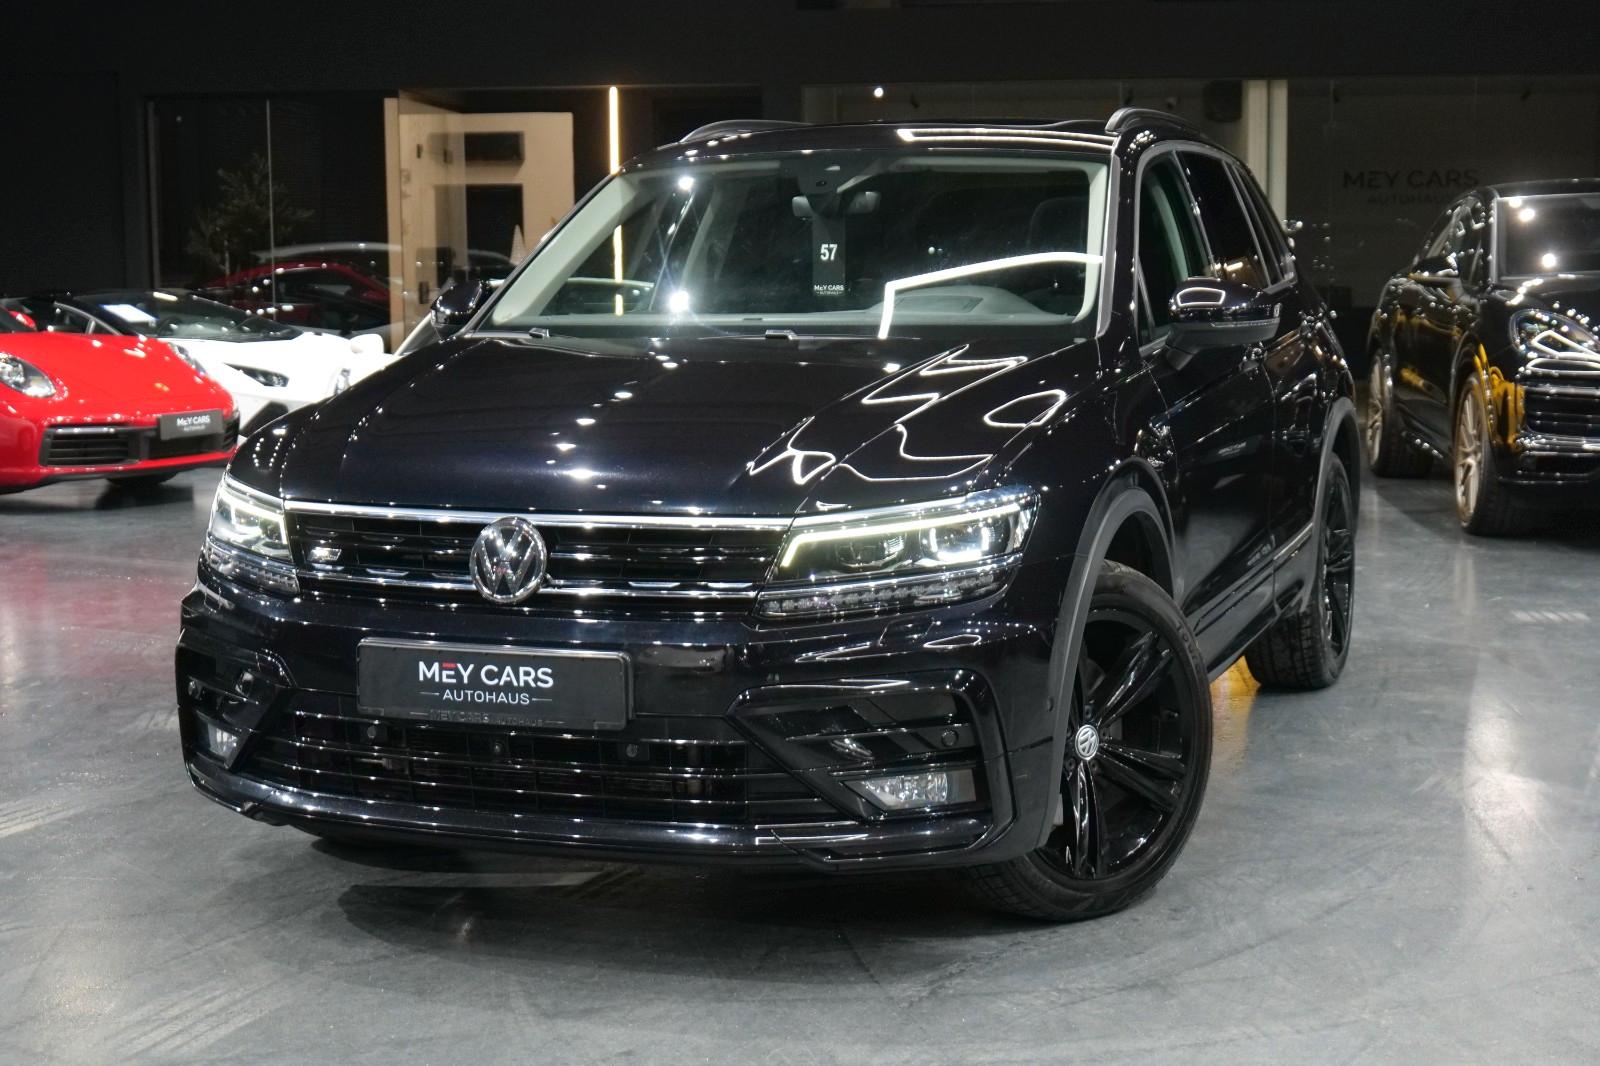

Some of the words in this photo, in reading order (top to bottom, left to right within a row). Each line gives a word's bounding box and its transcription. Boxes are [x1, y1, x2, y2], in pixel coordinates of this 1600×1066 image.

[1343, 170, 1400, 189] MEY
[1407, 169, 1479, 189] CARS
[820, 243, 838, 261] 57
[192, 414, 211, 424] CARS
[419, 661, 475, 683] MEY
[480, 665, 554, 688] CARS
[442, 689, 531, 705] AUTOHAUS
